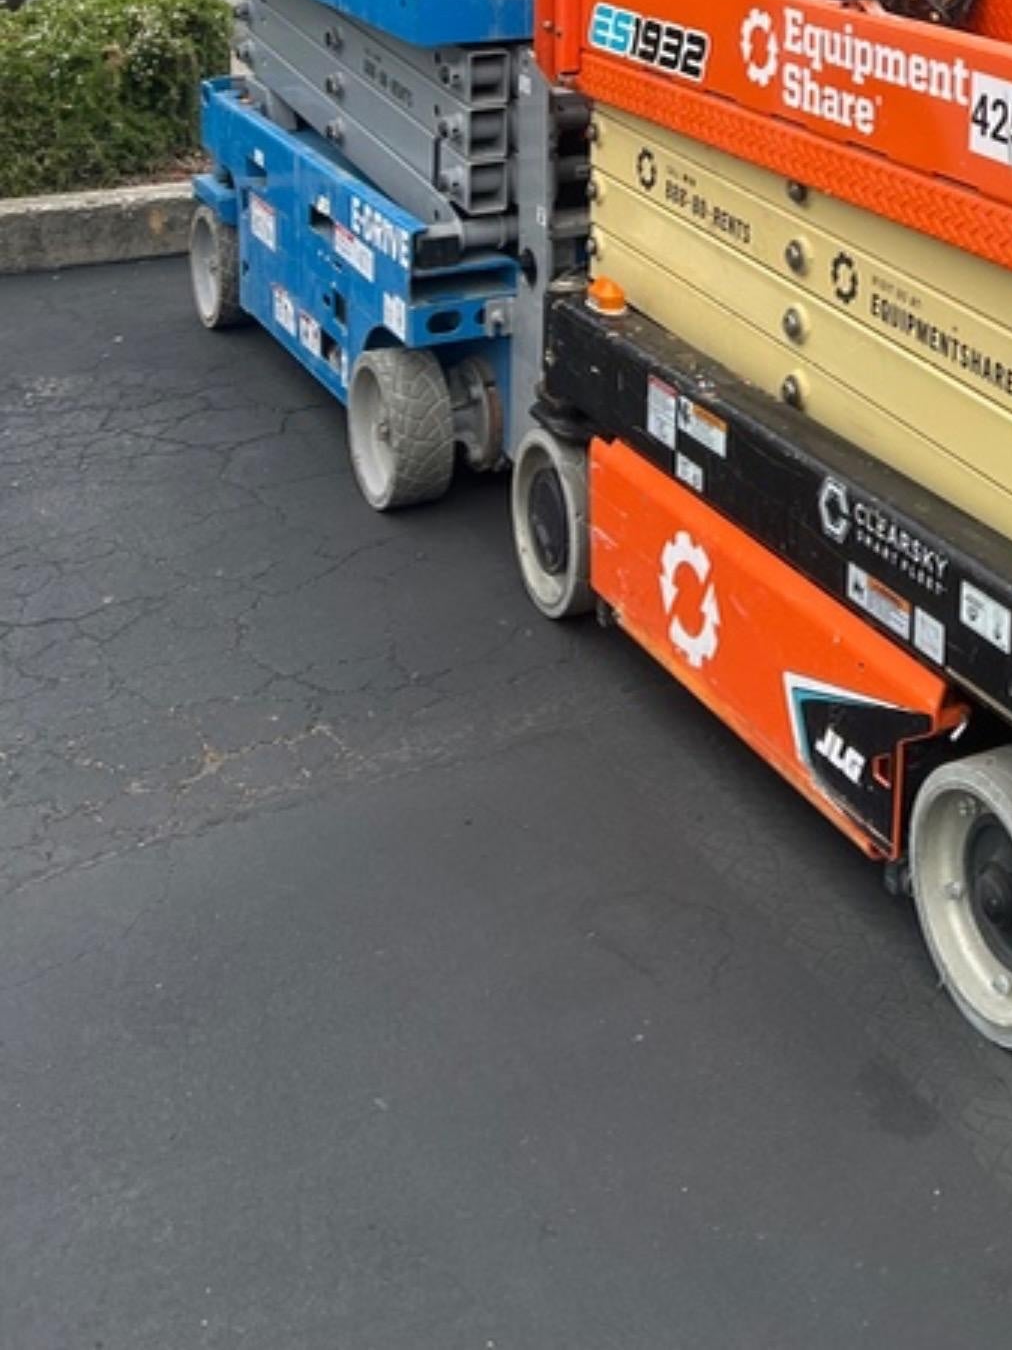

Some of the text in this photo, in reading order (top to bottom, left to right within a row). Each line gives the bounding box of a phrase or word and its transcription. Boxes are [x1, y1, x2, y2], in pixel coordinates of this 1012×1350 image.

[590, 3, 708, 79] ES1932
[783, 6, 969, 105] Equipment
[782, 61, 875, 135] Share
[854, 502, 949, 579] CLEARSKY
[815, 726, 866, 785] JLG
